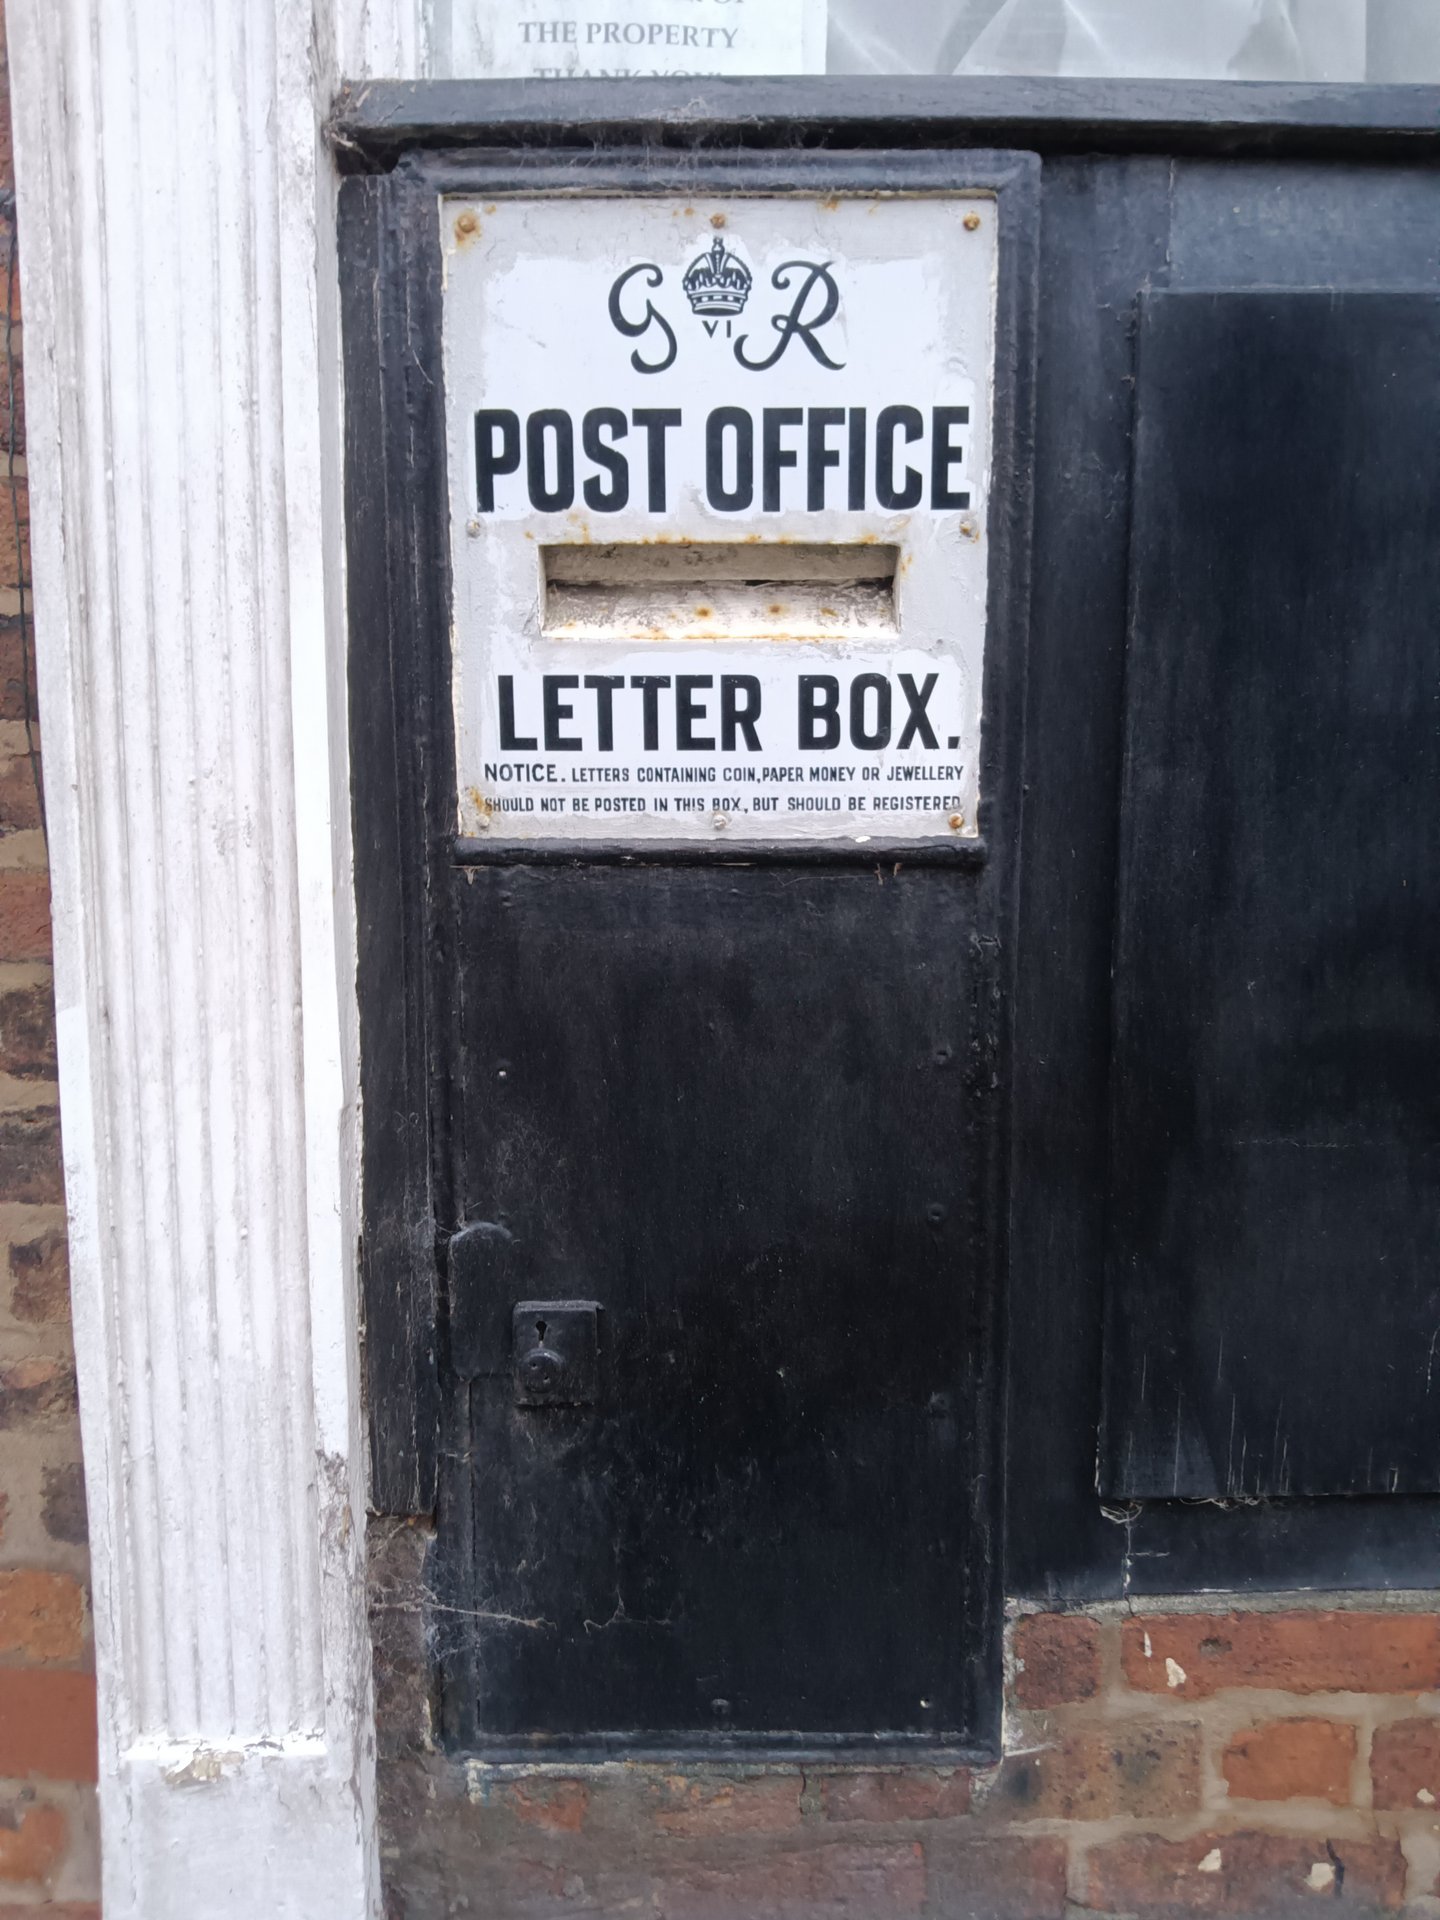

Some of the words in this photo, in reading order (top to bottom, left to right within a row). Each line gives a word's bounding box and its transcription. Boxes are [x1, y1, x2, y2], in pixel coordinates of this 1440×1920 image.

[518, 20, 578, 44] THE
[586, 22, 739, 48] PROPERTY
[702, 320, 732, 338] VI
[474, 407, 682, 513] POST
[706, 405, 970, 512] OFFICE
[498, 674, 763, 752] LETTER
[798, 672, 960, 751] BOX.
[484, 763, 566, 783] NOTICE.
[571, 767, 630, 783] LETTERS
[637, 766, 716, 783] CONTAINING
[809, 766, 856, 782] MONEY
[862, 766, 880, 781] OR
[886, 765, 964, 781] JEWELLERY
[484, 797, 534, 812] SHOULD
[540, 797, 566, 812] NOT
[572, 797, 590, 812] BE
[594, 797, 646, 812] POSTED
[654, 797, 668, 812] IN
[673, 797, 705, 812] THIS
[712, 797, 749, 814] BOX,
[752, 797, 779, 811] BUT
[787, 796, 841, 811] SHOULD
[848, 796, 866, 811] BE
[873, 795, 961, 811] REGISTERED
